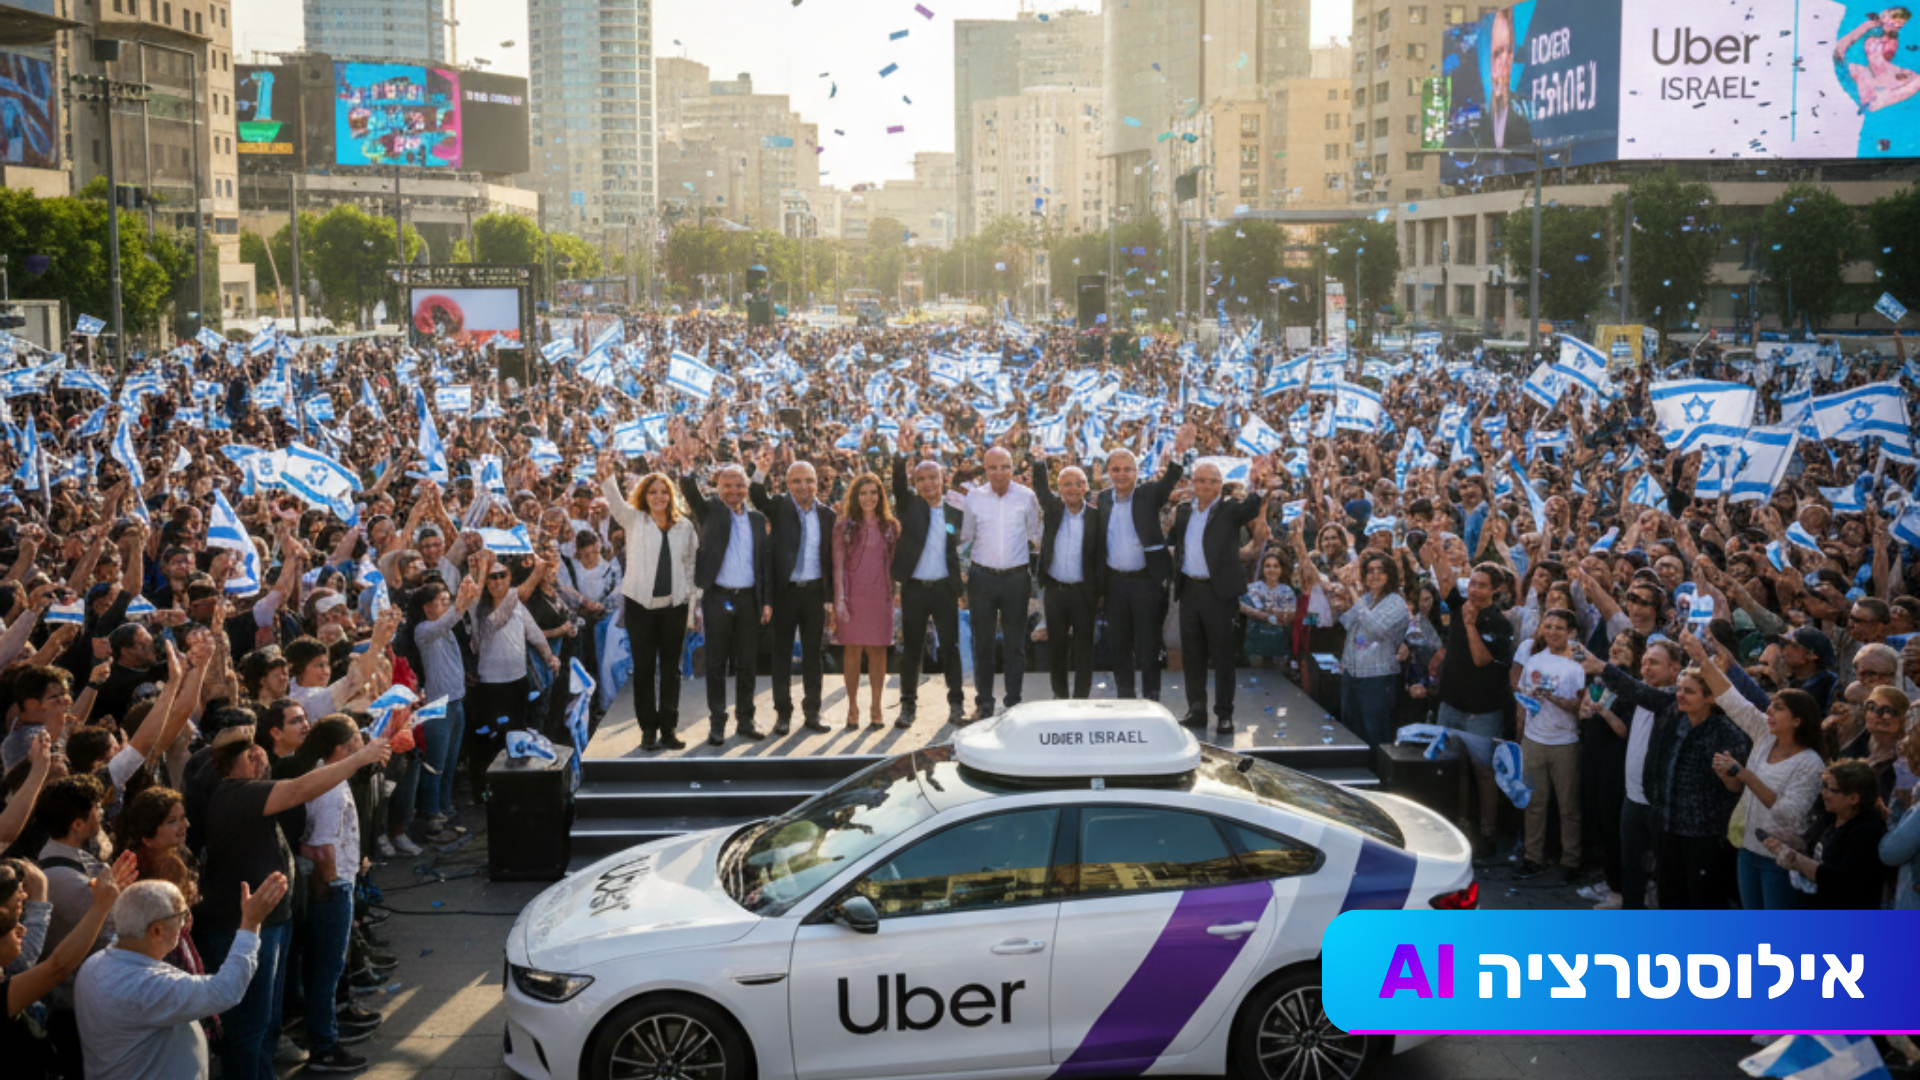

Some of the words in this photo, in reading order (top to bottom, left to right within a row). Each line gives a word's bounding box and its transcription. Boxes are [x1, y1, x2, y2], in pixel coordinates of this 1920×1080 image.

[1652, 26, 1760, 65] Uber
[1661, 75, 1756, 100] ISRAEL
[838, 973, 1025, 1035] Uber
